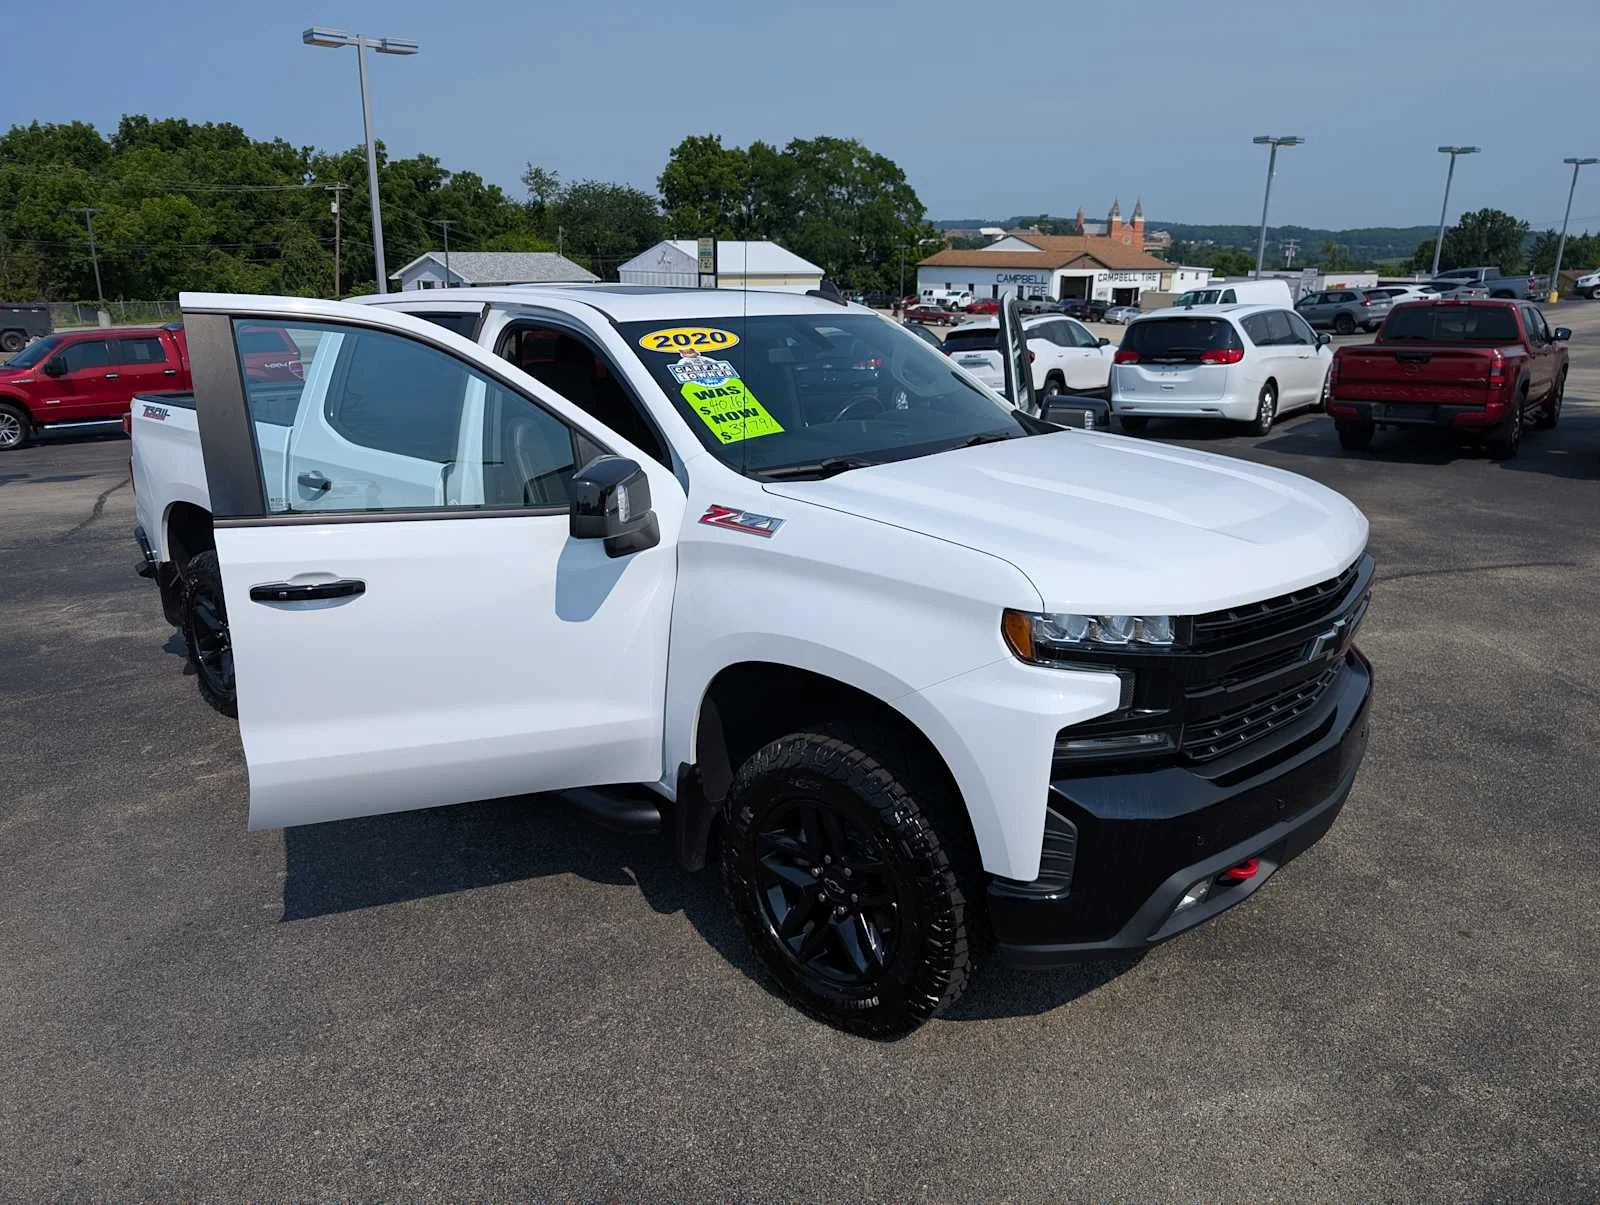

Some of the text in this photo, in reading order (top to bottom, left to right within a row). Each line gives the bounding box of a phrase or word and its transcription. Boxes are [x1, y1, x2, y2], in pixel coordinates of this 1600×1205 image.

[996, 273, 1048, 285] CAMPBELL
[1097, 272, 1157, 282] CAMPBELL TIRE
[1026, 285, 1048, 296] TIRE
[653, 331, 728, 349] 2020
[693, 386, 741, 400] WAS
[711, 408, 759, 424] NOW
[698, 504, 784, 538] Z71
